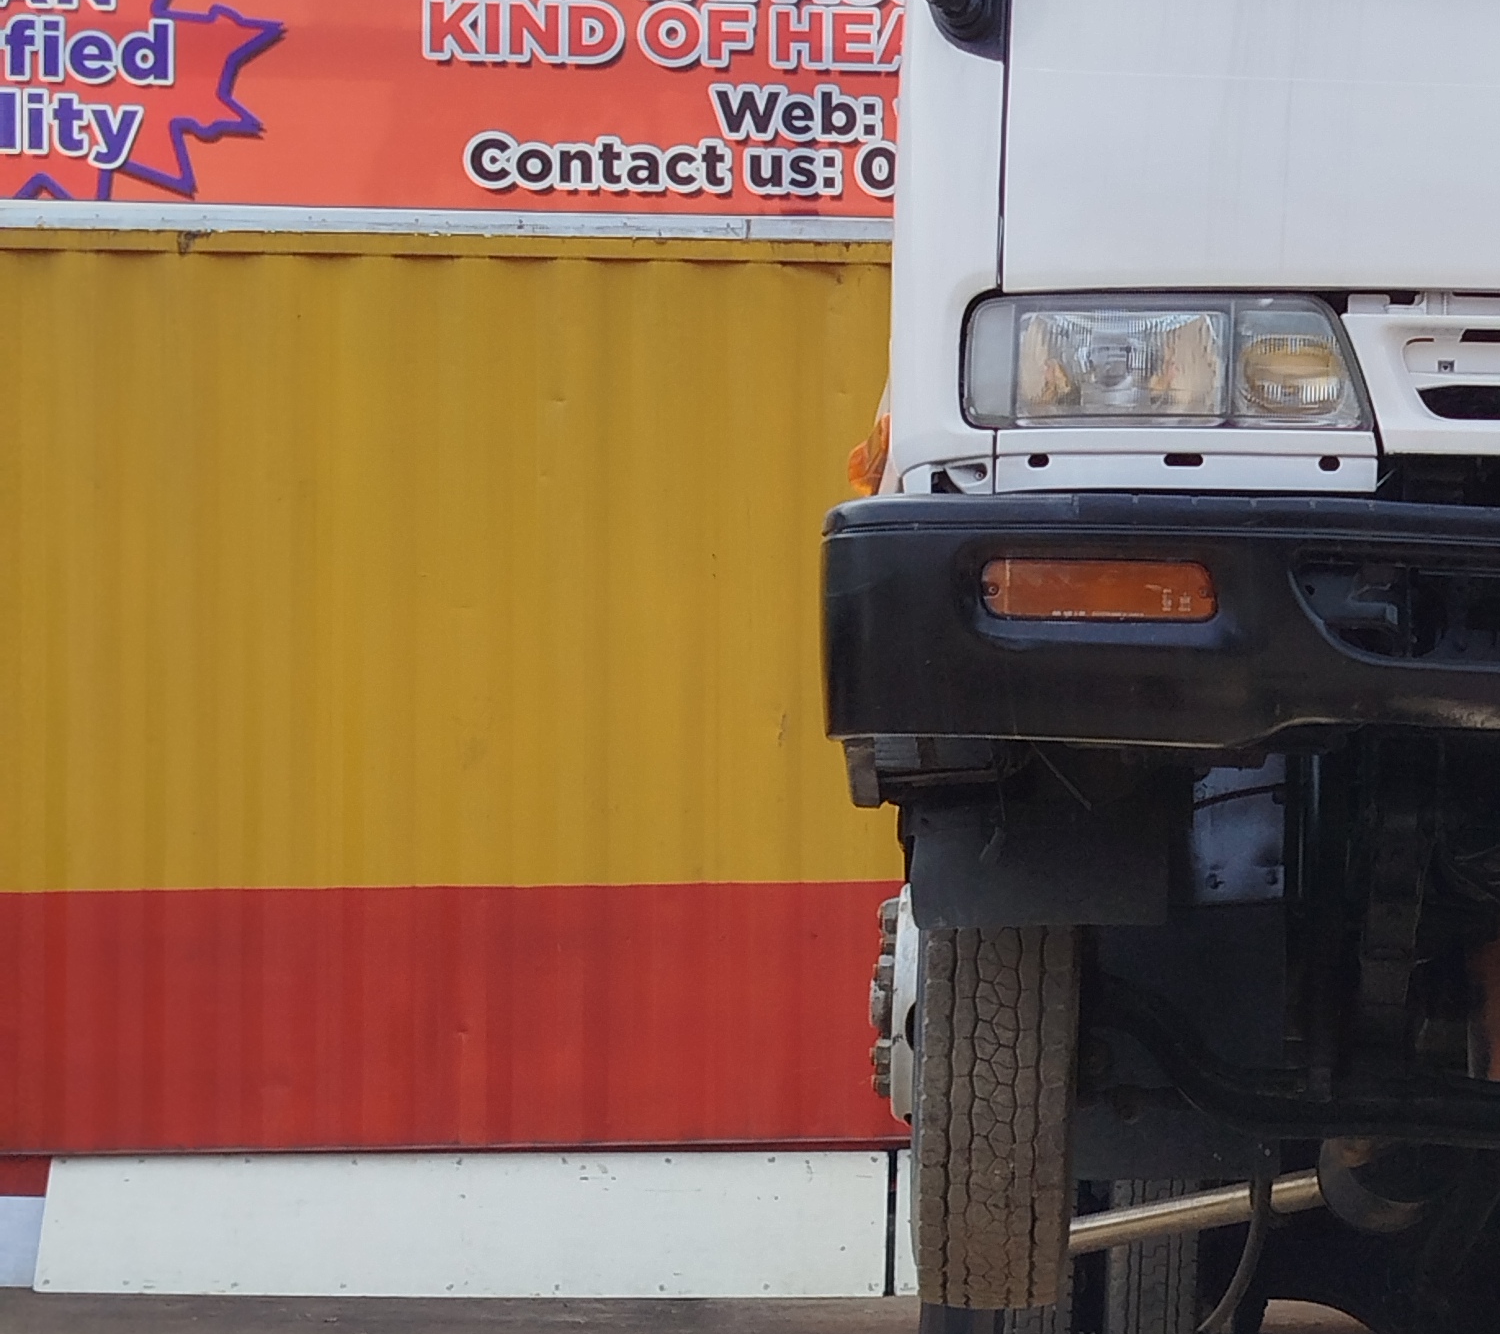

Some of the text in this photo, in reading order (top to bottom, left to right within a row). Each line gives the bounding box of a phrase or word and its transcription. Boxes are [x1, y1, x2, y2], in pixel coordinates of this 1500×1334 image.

[4, 13, 175, 86] fied
[636, 0, 755, 67] OF
[0, 86, 144, 168] lity
[710, 85, 882, 142] Web:
[464, 130, 732, 193] Contact
[743, 147, 842, 196] us:
